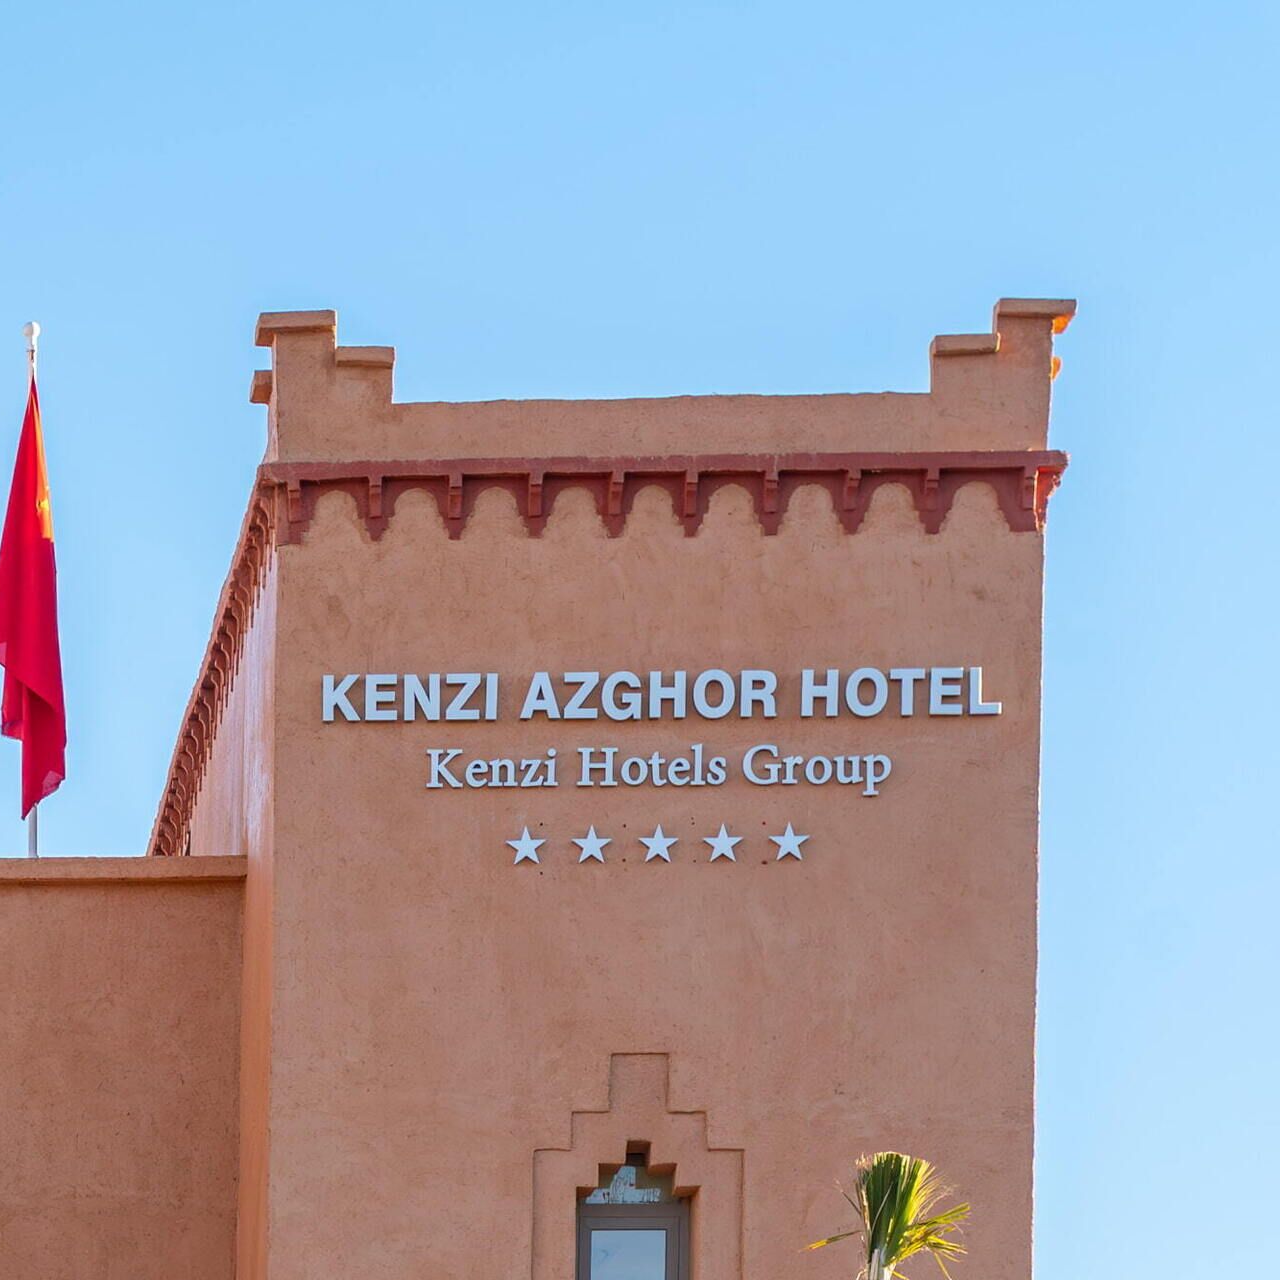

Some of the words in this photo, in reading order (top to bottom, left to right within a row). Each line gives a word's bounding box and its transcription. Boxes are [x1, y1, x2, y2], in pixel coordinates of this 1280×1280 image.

[322, 672, 499, 722] KENZI
[520, 668, 778, 720] AZGHOR
[800, 665, 1004, 717] HOTEL
[425, 748, 559, 788] Kenzi
[576, 743, 727, 787] Hotels
[742, 743, 893, 796] Group
